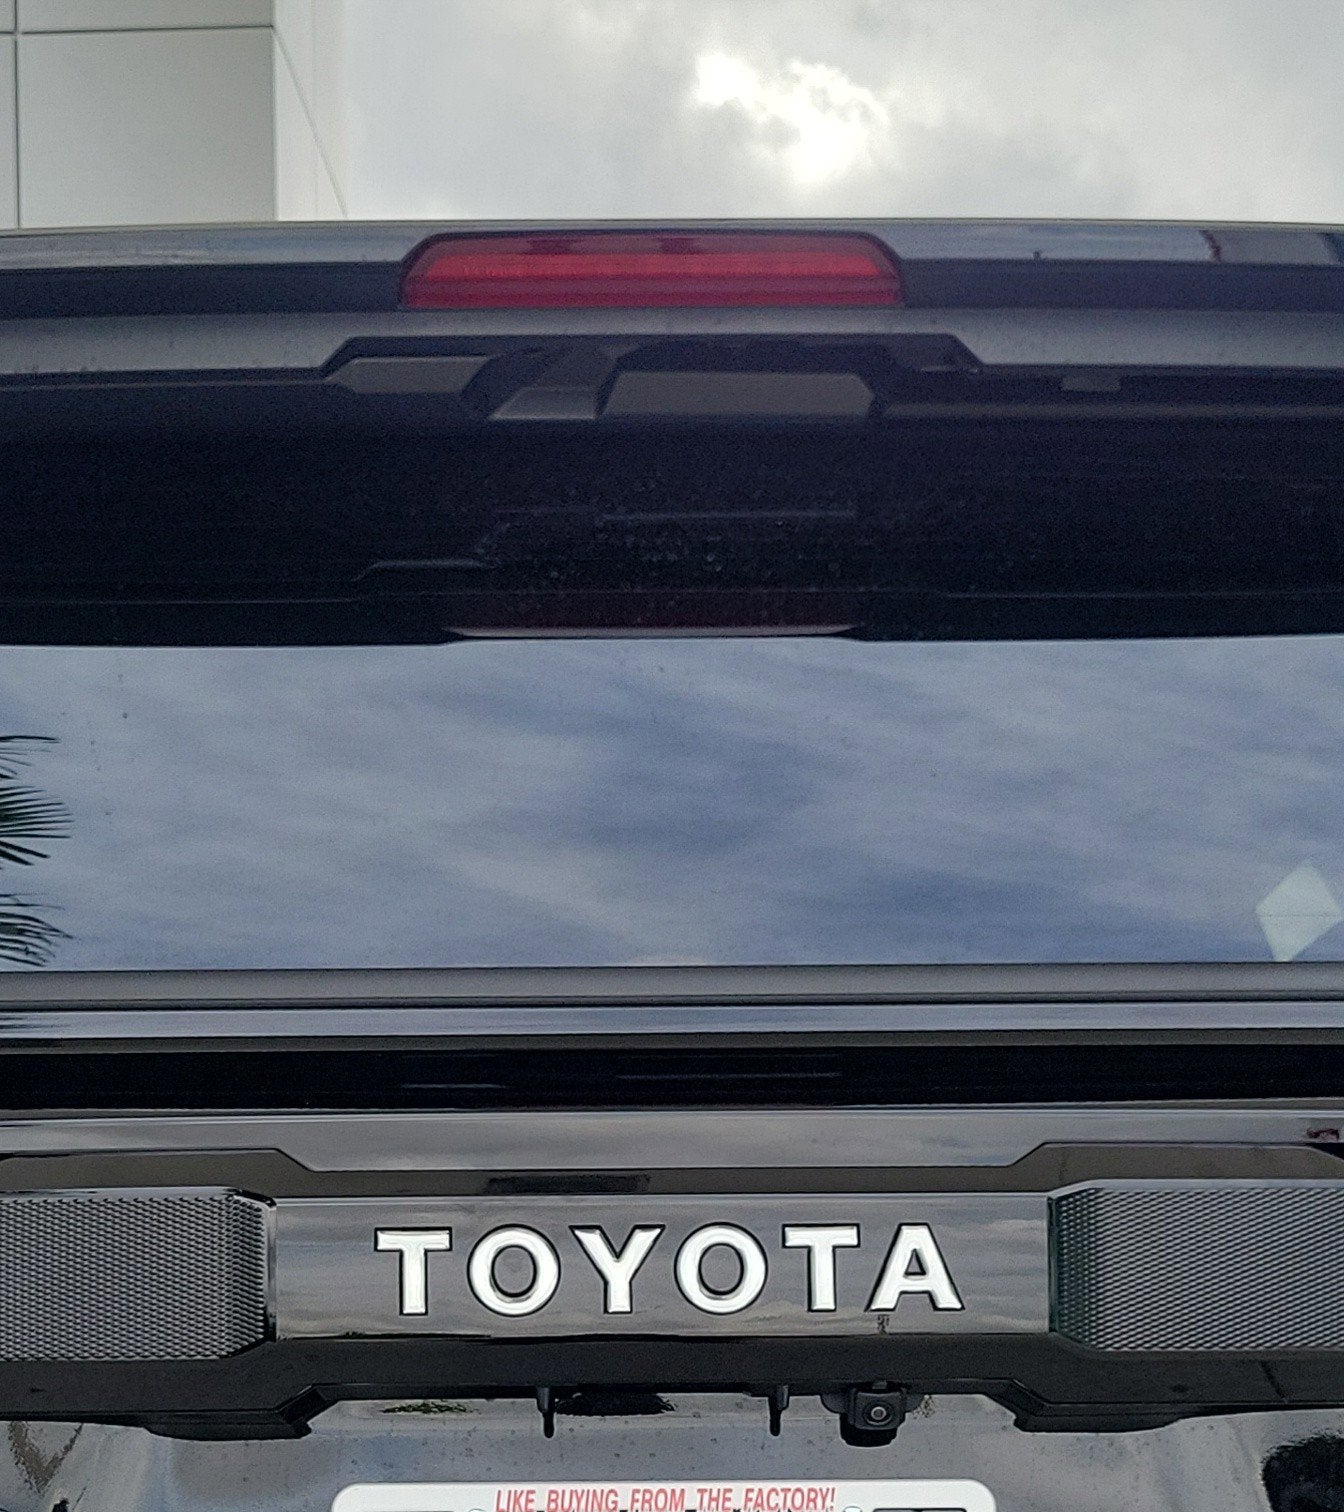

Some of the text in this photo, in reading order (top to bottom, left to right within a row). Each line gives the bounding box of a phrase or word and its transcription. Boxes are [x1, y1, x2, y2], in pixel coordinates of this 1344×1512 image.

[374, 1222, 965, 1316] TOYOTA
[545, 1489, 619, 1512] BUYING
[630, 1488, 686, 1512] FROM
[697, 1487, 733, 1512] THE
[744, 1487, 836, 1512] FACTORY!
